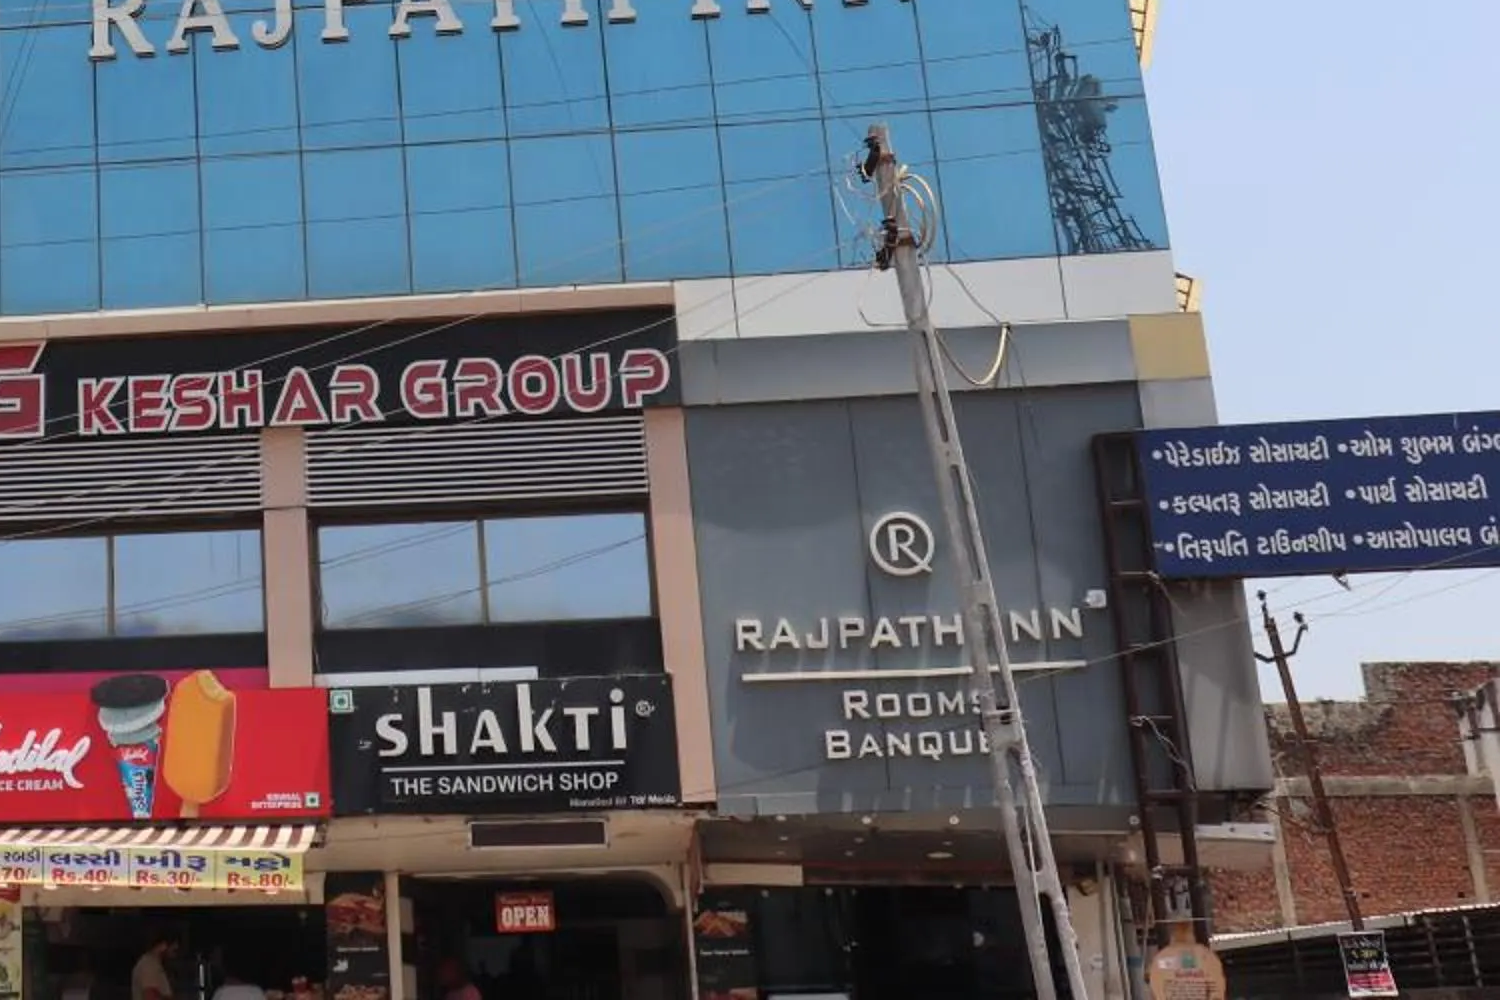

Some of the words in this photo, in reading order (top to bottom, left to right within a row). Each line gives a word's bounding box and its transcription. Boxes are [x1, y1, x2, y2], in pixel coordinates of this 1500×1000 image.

[78, 364, 384, 435] KESHAR
[400, 347, 671, 418] GROUP
[1249, 435, 1330, 463] સોસાયટી
[1401, 434, 1455, 465] શુભમ
[1249, 481, 1330, 510] સોસાયટી
[1404, 473, 1488, 502] સોસાયટી
[1366, 521, 1472, 549] આસોપાલવ
[735, 613, 965, 651] RAJPATH
[1006, 607, 1083, 642] NN
[825, 729, 991, 761] BANQUE
[17, 779, 63, 792] CREAM
[390, 778, 433, 796] THE
[438, 773, 555, 794] SANDWICH
[559, 771, 619, 791] SHOP
[501, 905, 550, 927] OPEN
